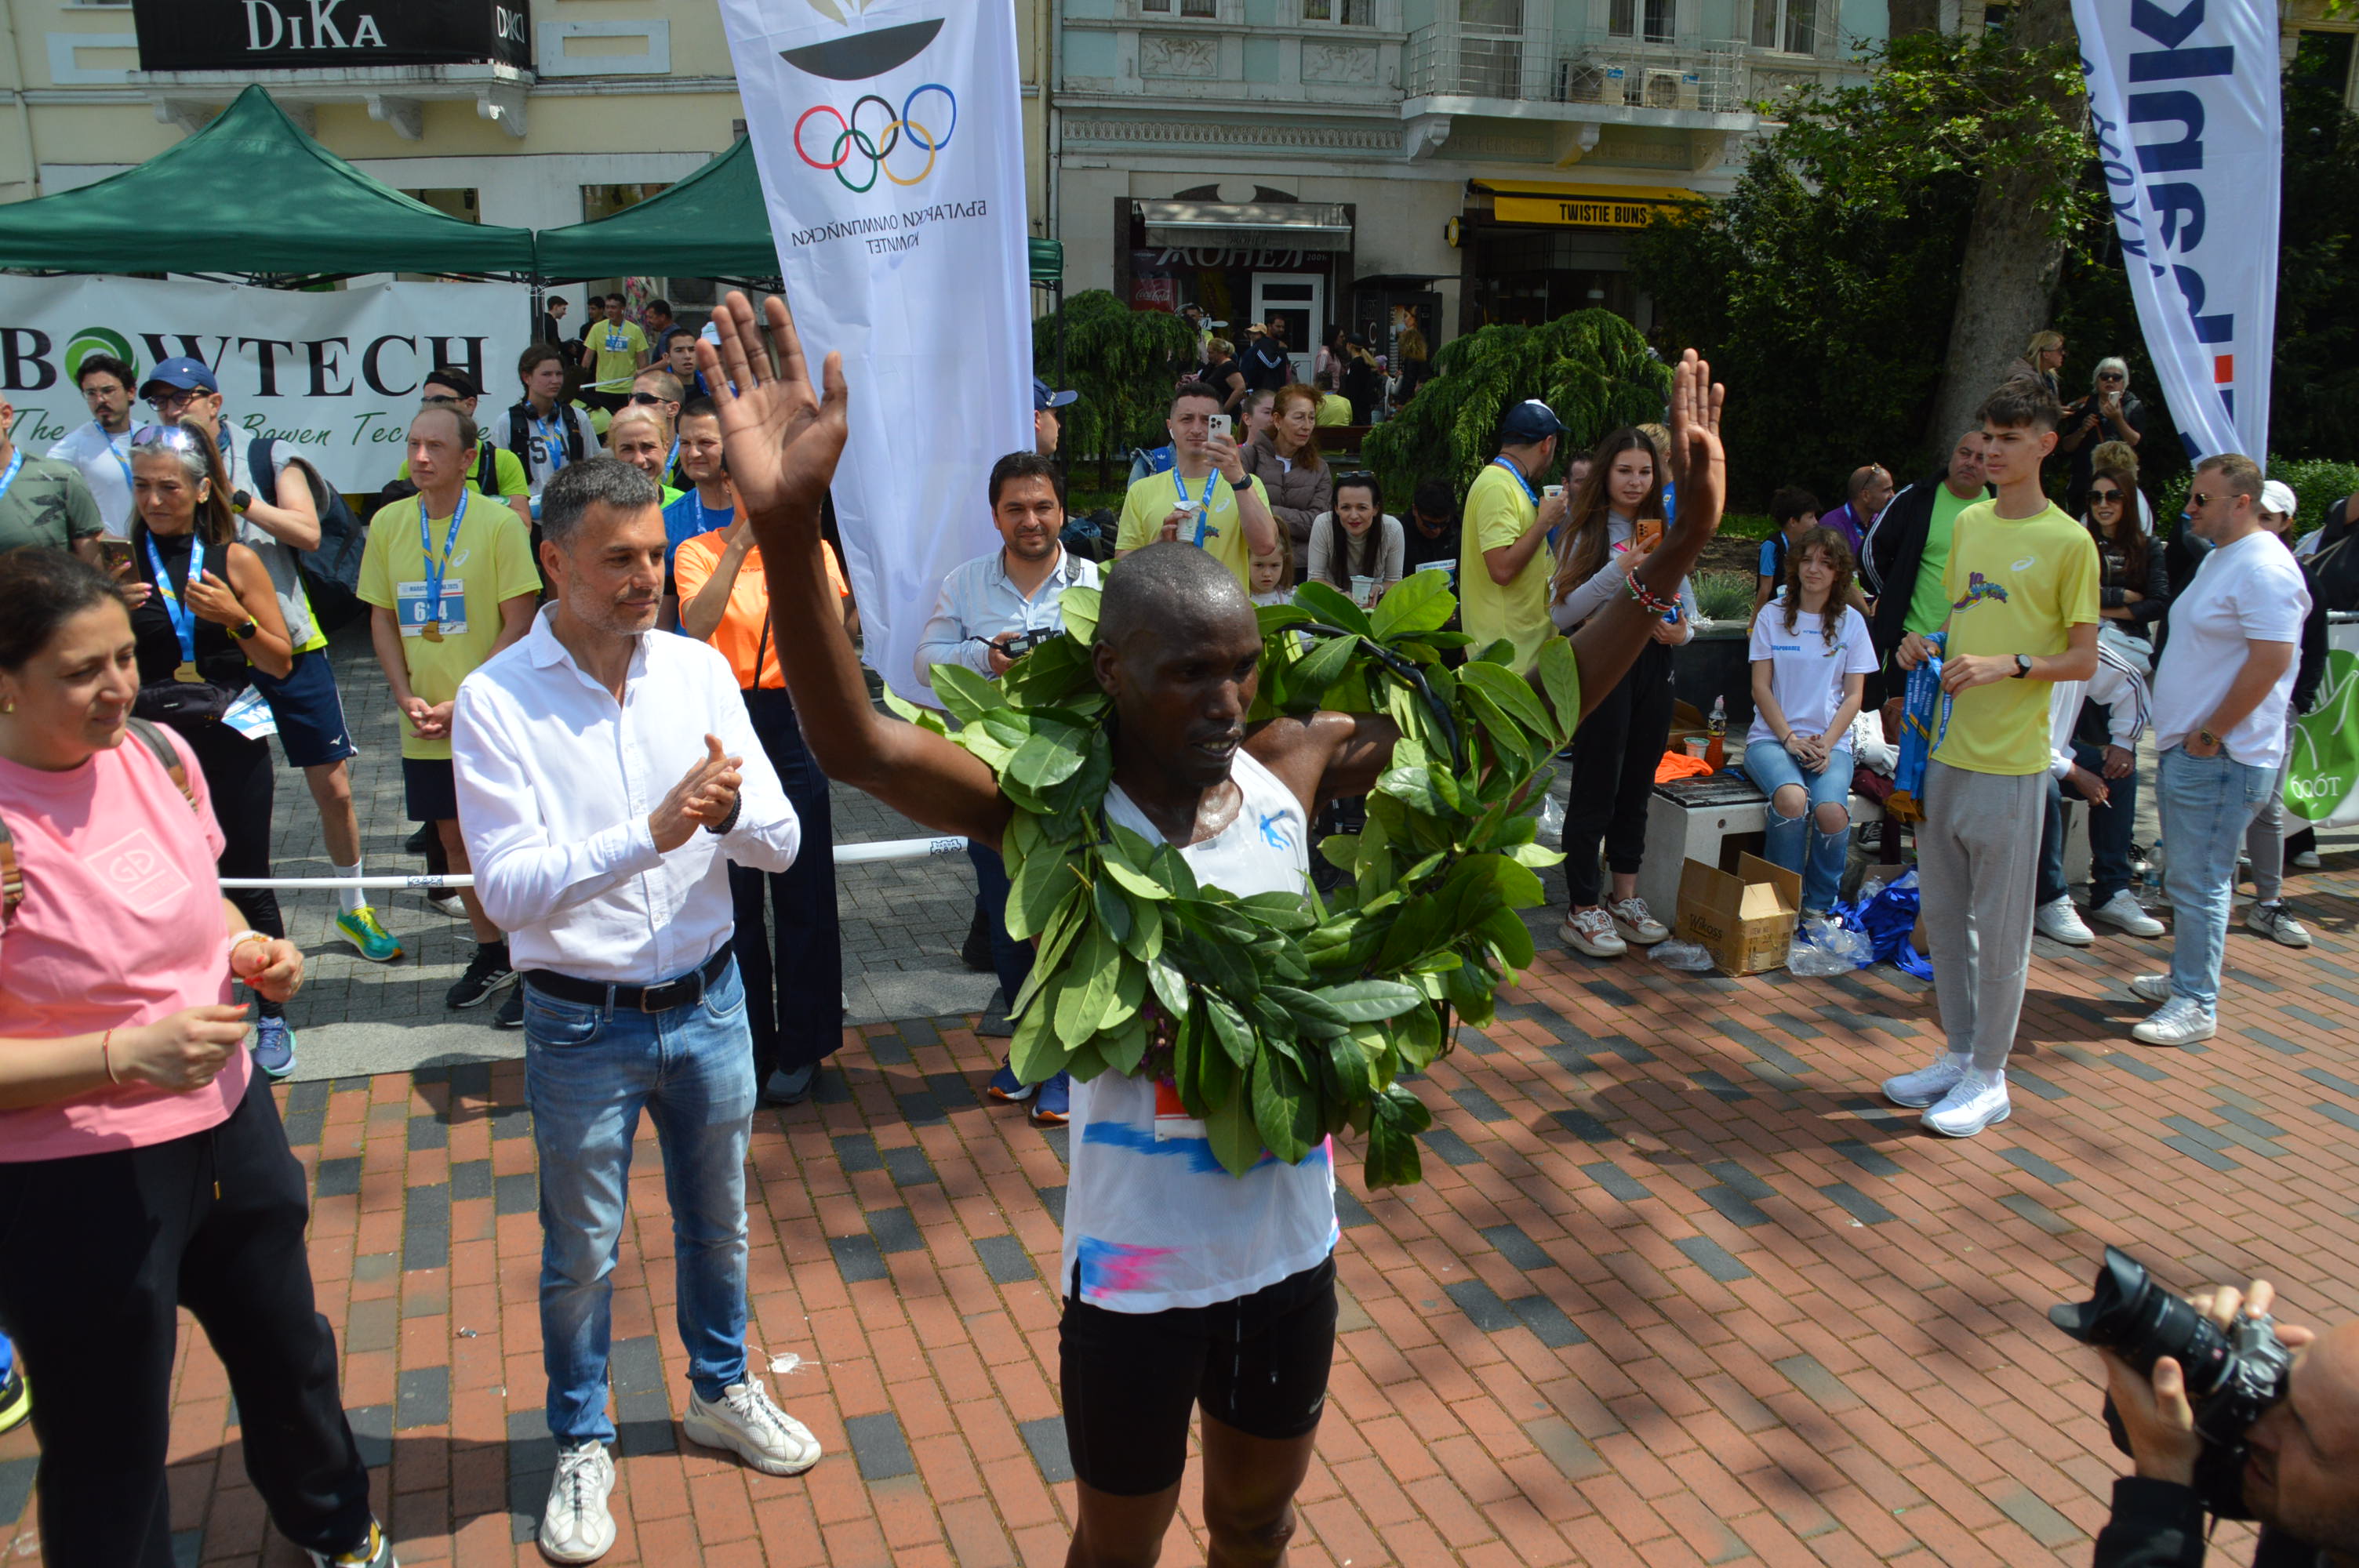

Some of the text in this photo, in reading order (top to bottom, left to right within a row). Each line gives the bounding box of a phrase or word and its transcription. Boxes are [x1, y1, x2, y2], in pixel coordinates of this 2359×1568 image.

[1559, 203, 1647, 225] TWISTIE BUNS
[7, 408, 67, 442] The
[414, 600, 449, 622] 64
[1690, 913, 1724, 940] Wikoss
